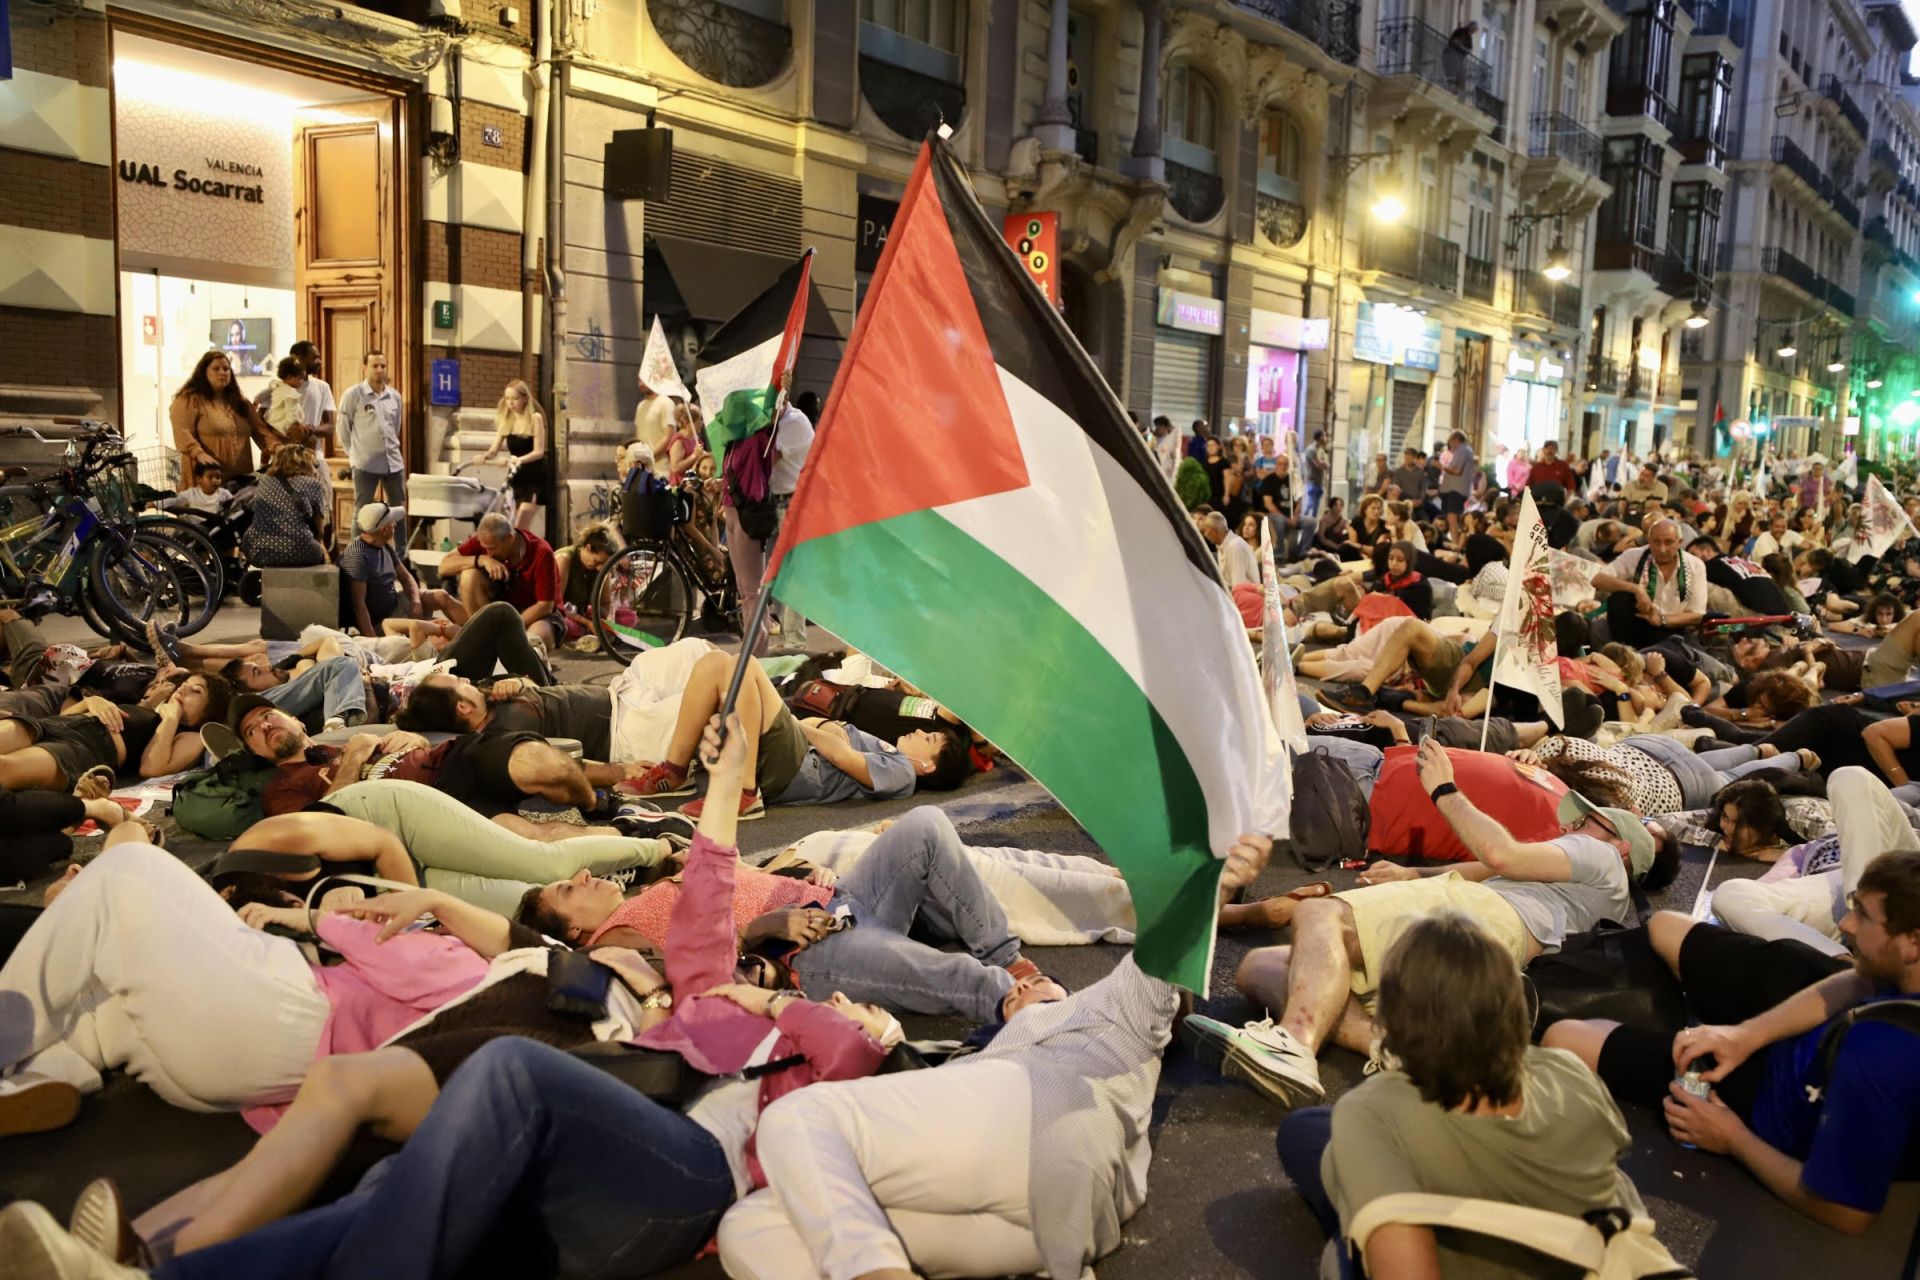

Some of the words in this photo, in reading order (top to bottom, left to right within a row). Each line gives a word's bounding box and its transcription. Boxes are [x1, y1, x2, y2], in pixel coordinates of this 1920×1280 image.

[484, 128, 501, 145] 38
[205, 157, 264, 178] VALENCIA
[173, 169, 265, 204] Socarrat
[438, 373, 452, 391] H
